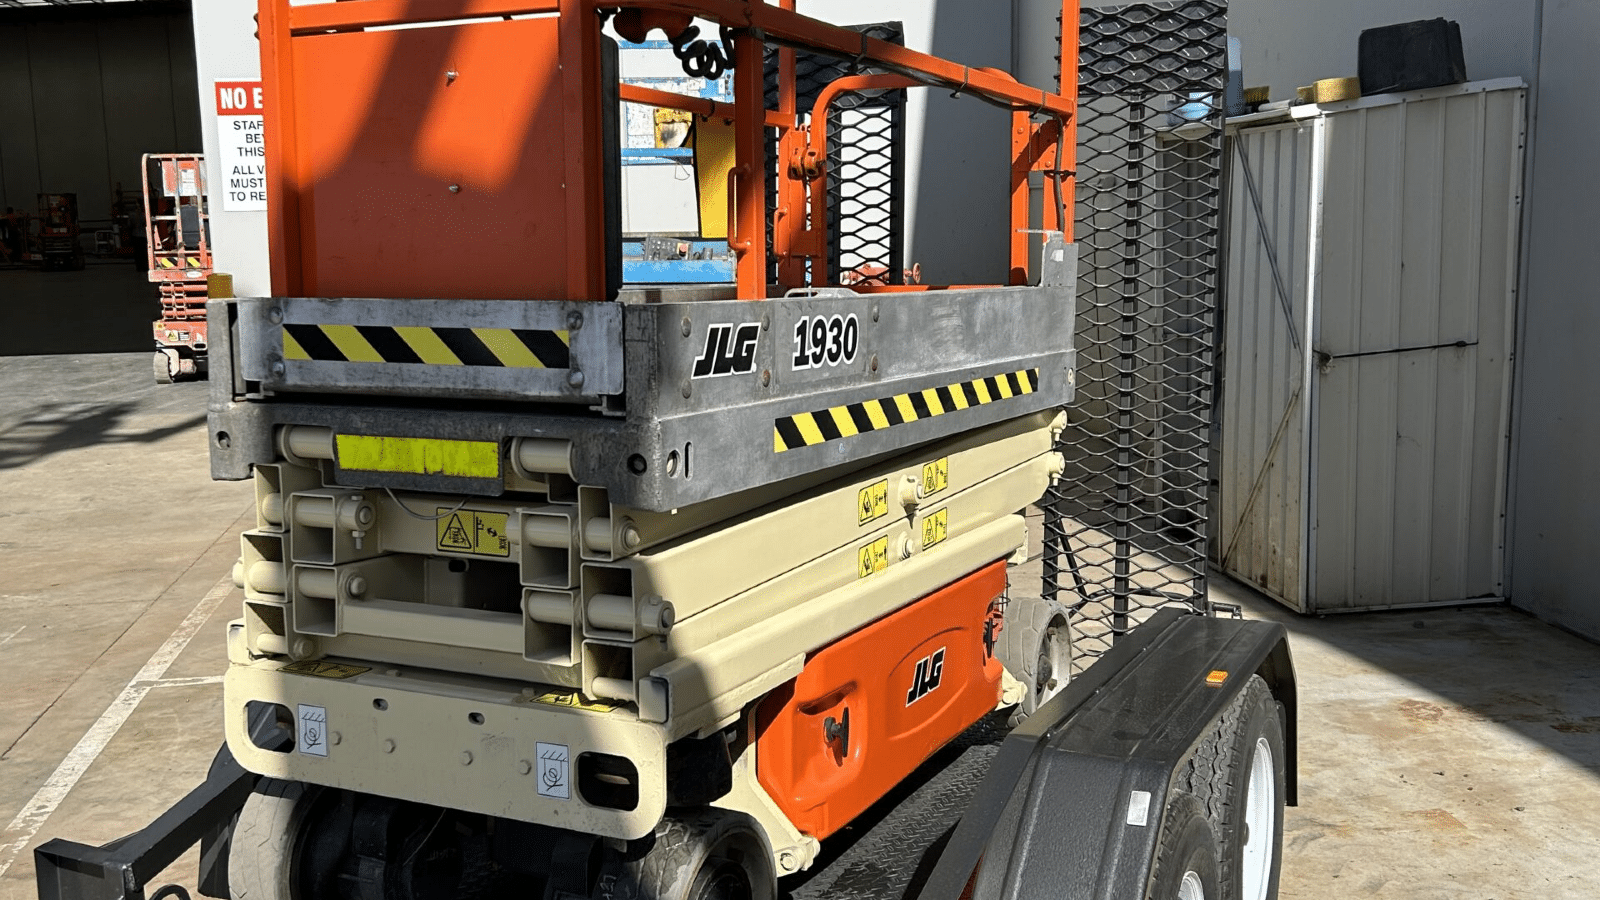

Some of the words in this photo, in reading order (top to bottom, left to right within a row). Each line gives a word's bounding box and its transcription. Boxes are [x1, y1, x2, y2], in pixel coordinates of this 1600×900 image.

[219, 87, 248, 110] NO
[245, 133, 265, 144] BE
[237, 146, 265, 157] THIS
[232, 165, 255, 175] ALL
[230, 178, 264, 188] MUST
[229, 191, 246, 201] TO
[793, 315, 859, 369] 1930
[692, 324, 760, 378] JLG
[906, 647, 946, 707] JLG
